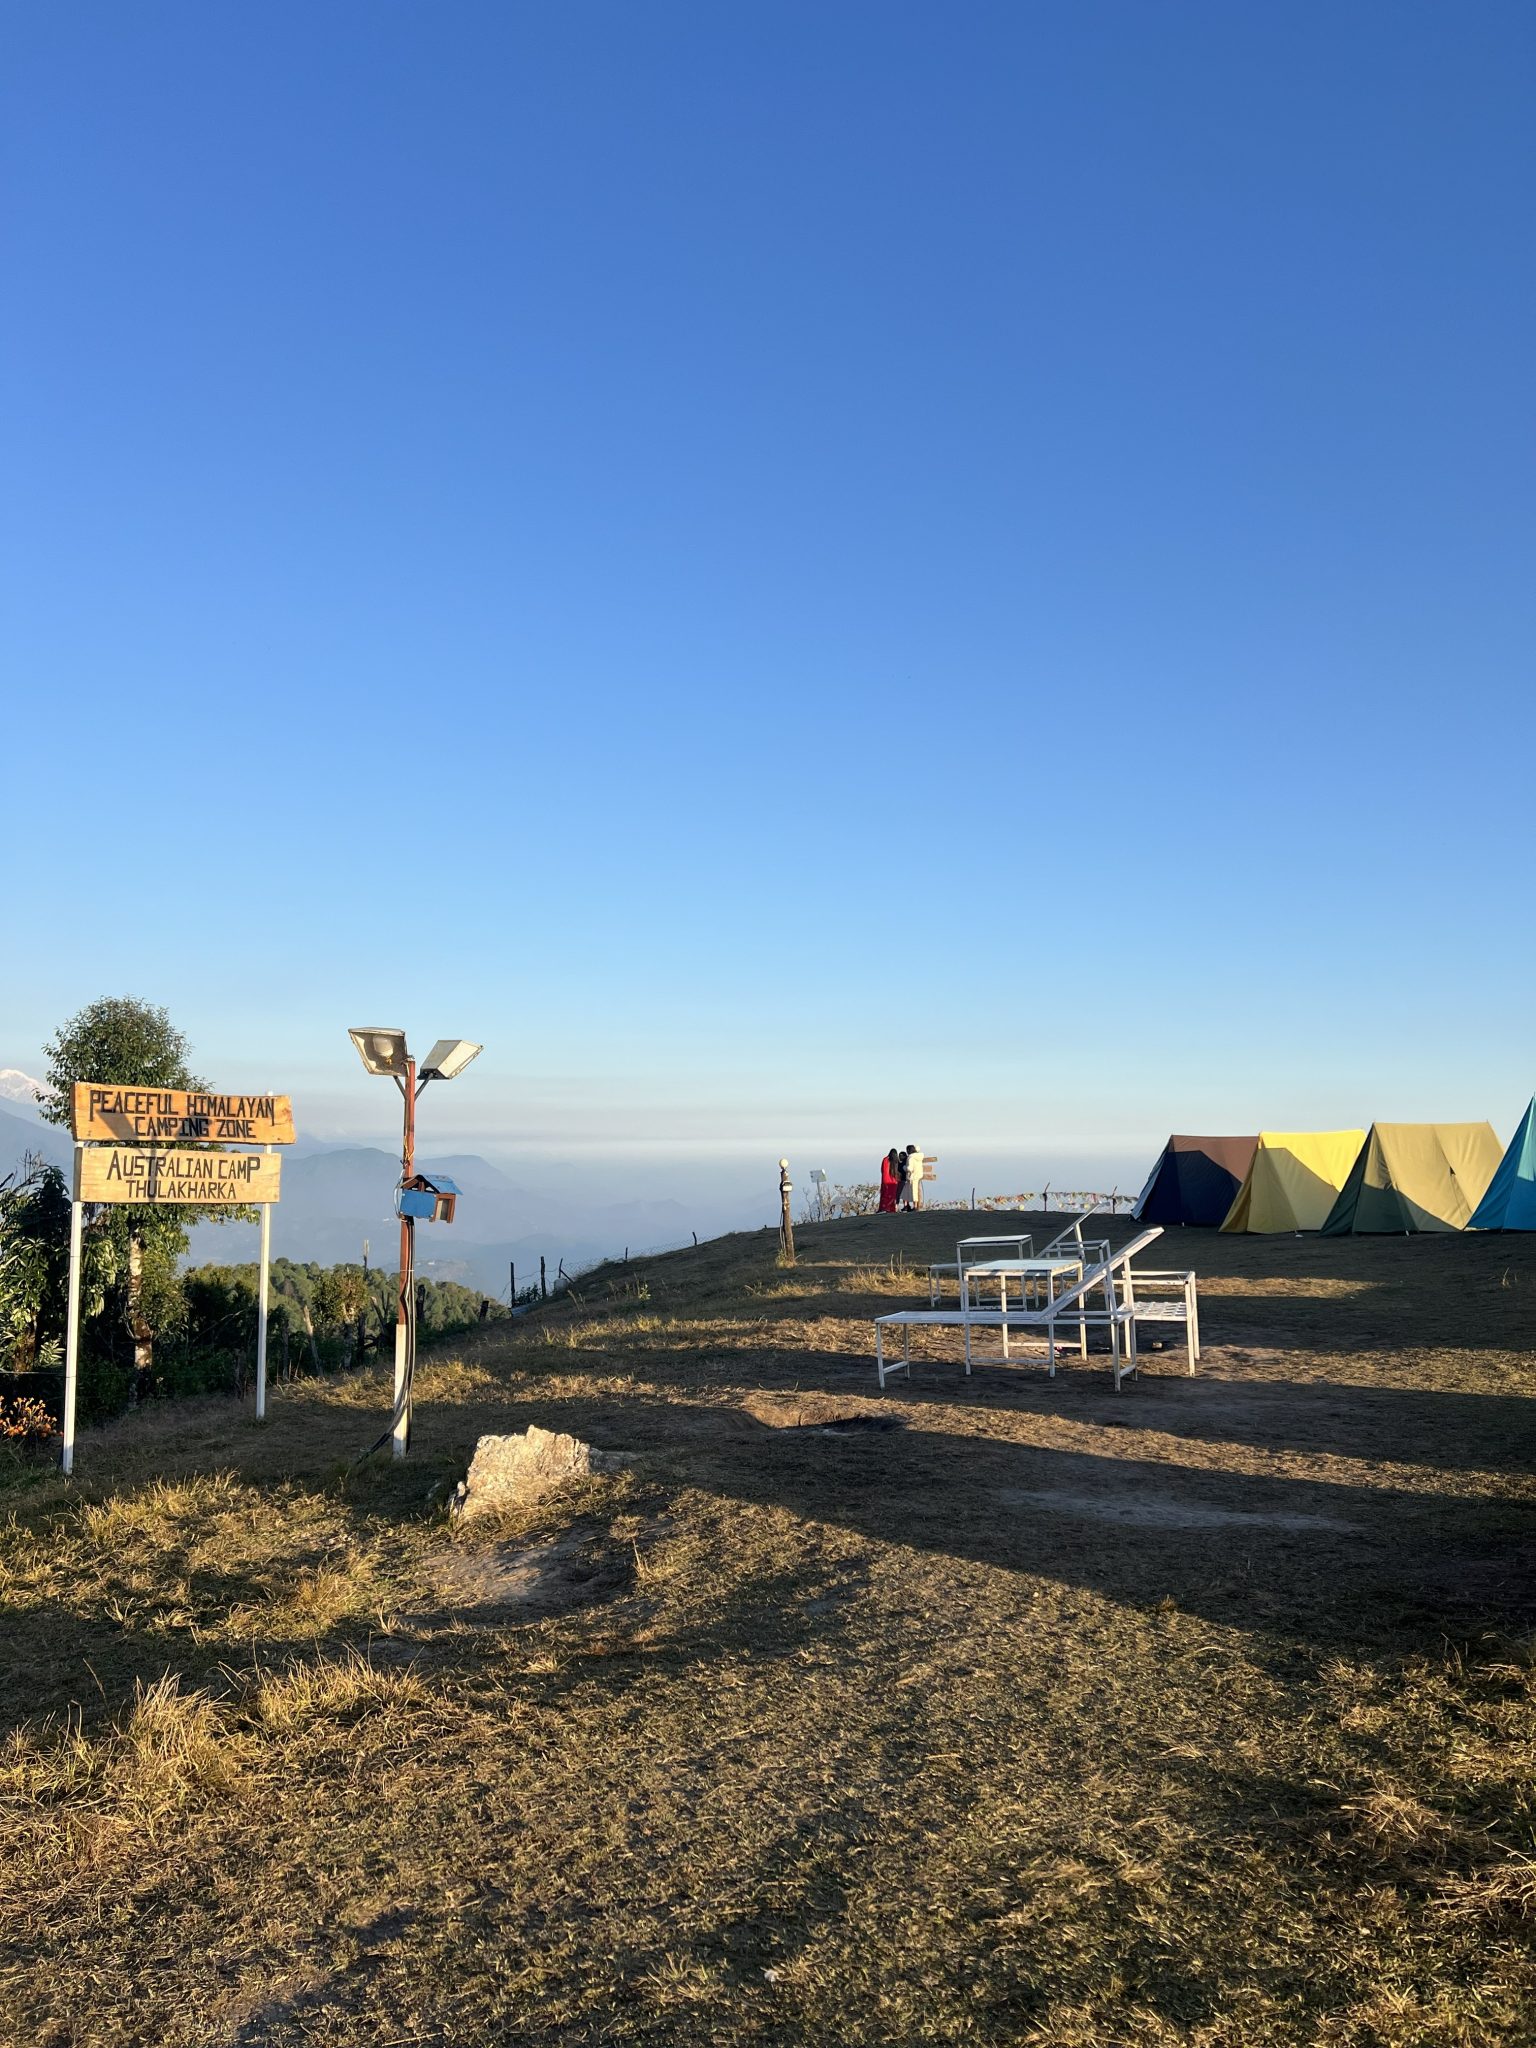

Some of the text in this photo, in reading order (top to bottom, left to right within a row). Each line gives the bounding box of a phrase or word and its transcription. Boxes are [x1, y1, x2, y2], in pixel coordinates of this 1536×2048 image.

[89, 1090, 275, 1126] PEACEFUL HIMALAYAN
[134, 1117, 256, 1138] CAMPING ZONE
[107, 1150, 261, 1183] AUSTRALIAN CAMP
[126, 1179, 236, 1199] THULAKHARKA
